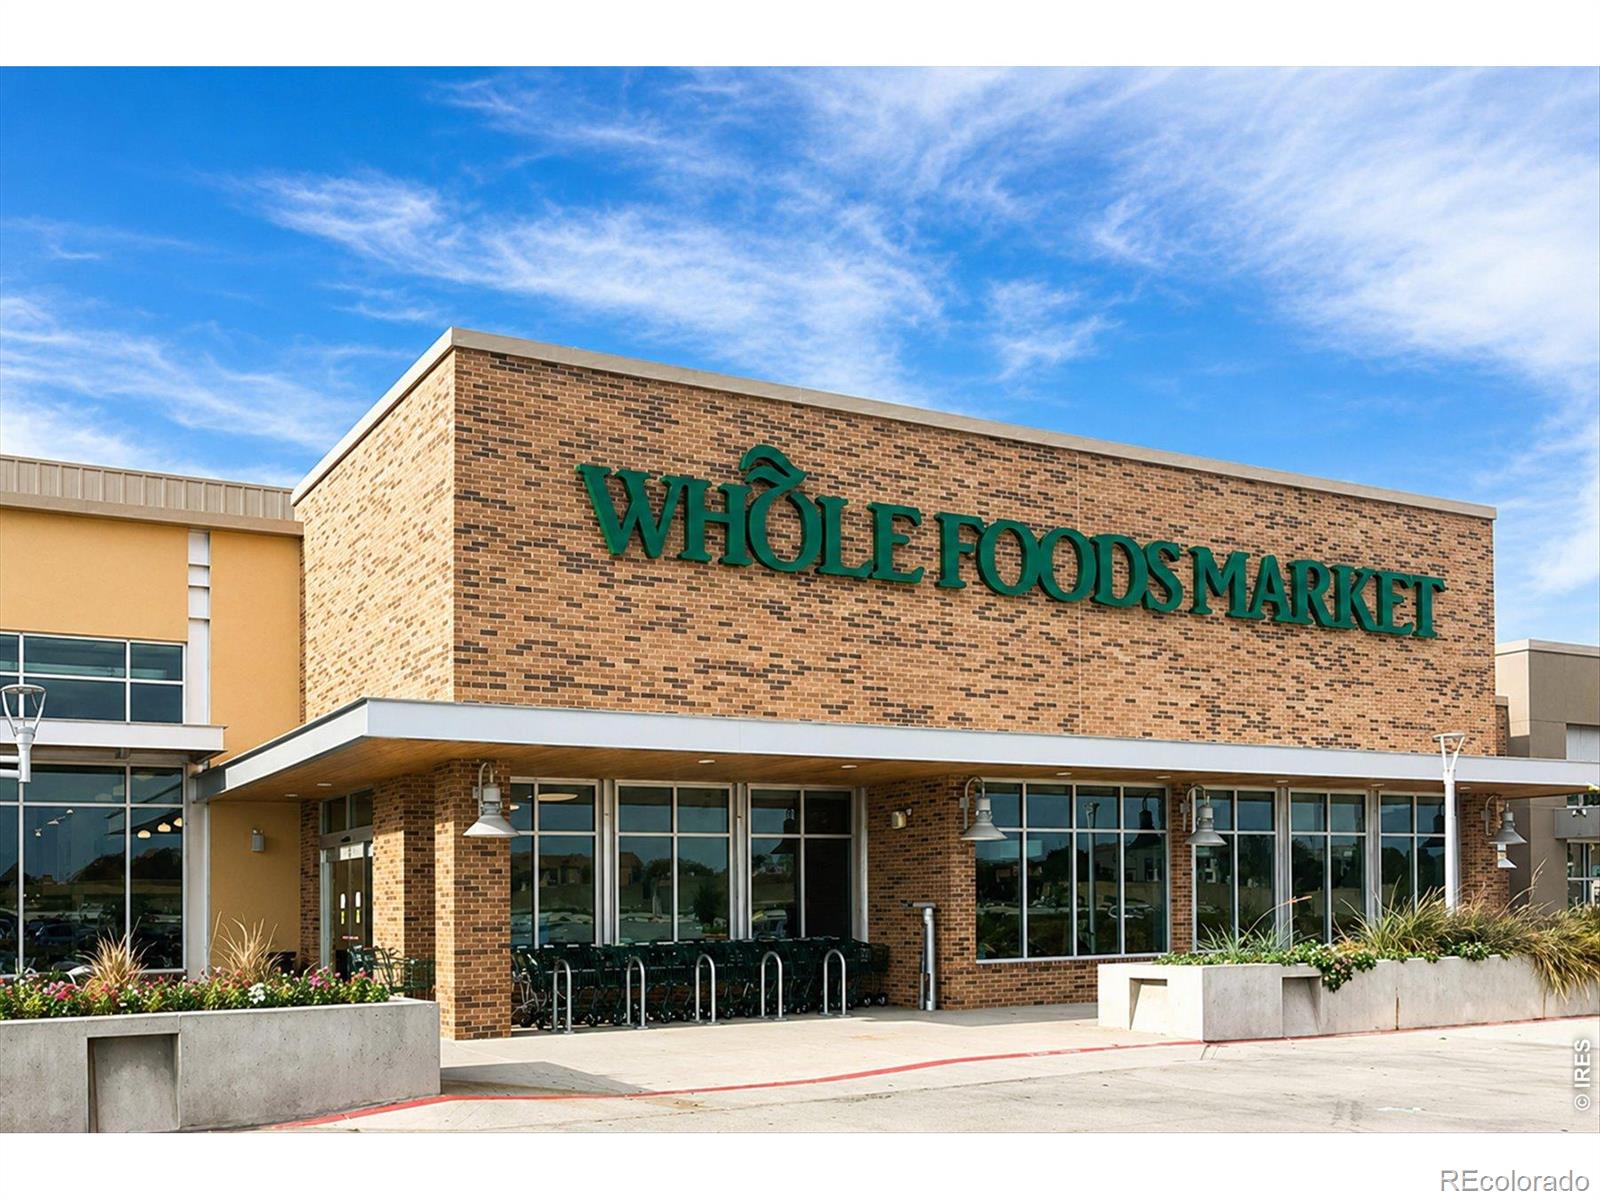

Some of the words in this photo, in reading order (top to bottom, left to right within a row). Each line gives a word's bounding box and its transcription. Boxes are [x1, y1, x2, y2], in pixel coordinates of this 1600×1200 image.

[577, 444, 924, 584] WHOLE
[936, 512, 1183, 613] FOODS
[1189, 546, 1445, 639] MARKET
